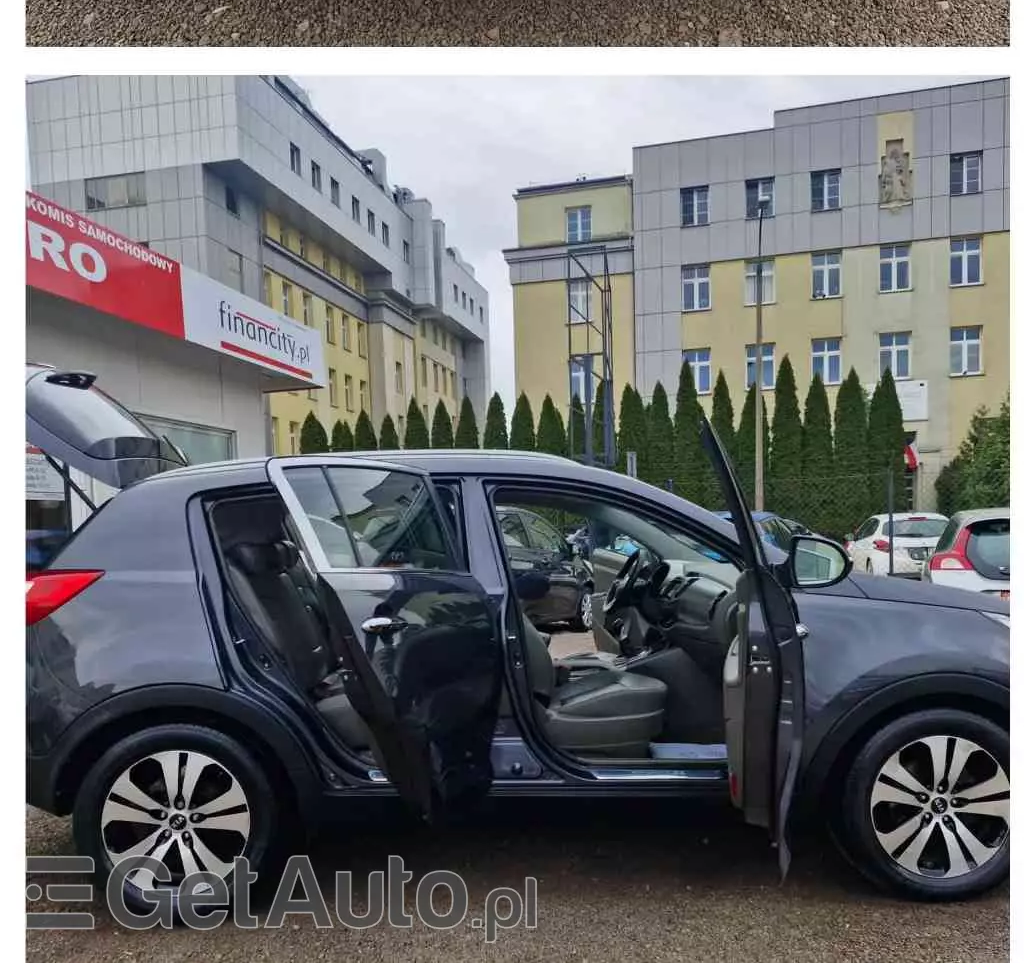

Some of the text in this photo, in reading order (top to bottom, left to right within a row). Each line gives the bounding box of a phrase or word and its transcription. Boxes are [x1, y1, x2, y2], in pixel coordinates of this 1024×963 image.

[26, 197, 173, 273] KOMIS SAMOCHODOWY
[26, 220, 107, 283] RO
[218, 300, 310, 365] financity.pl
